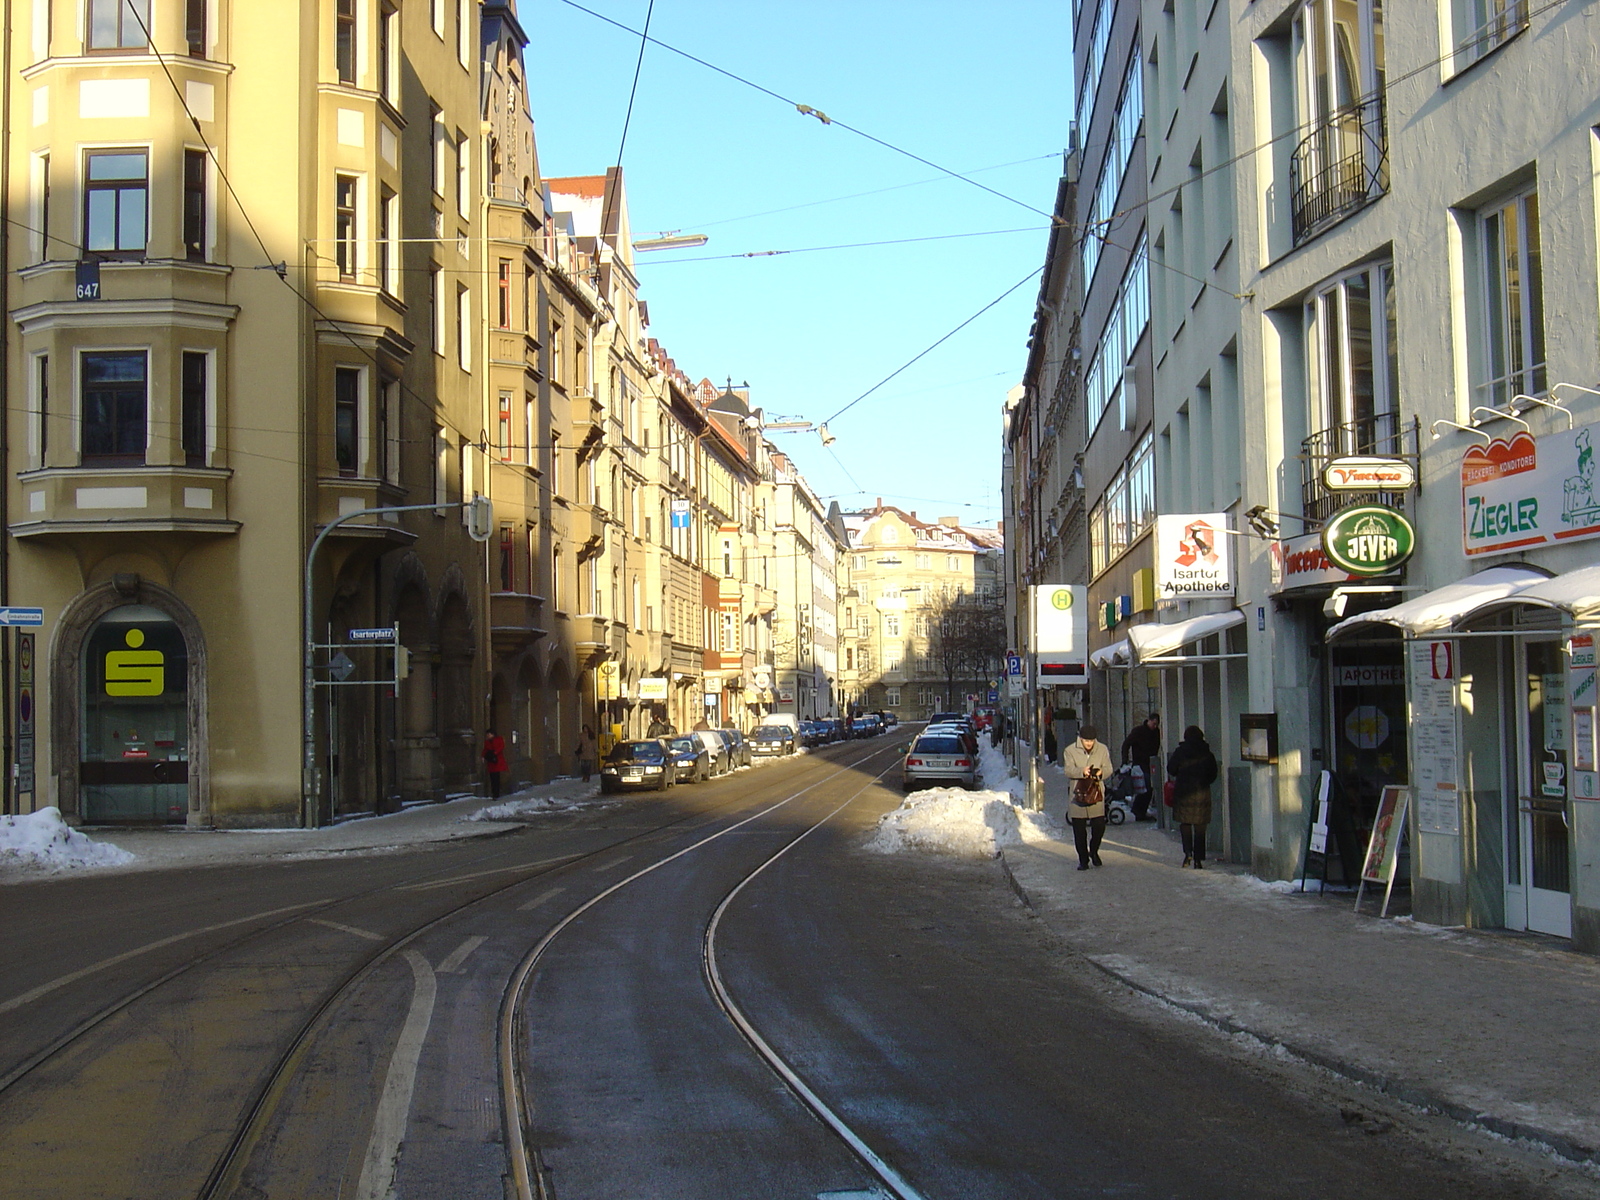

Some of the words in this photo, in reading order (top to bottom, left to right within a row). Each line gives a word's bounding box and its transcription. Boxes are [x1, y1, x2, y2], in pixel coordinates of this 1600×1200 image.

[77, 283, 99, 299] 647
[1467, 465, 1495, 482] BÄCKEREI
[1499, 454, 1536, 473] KONDITOREI
[1346, 534, 1399, 562] JEVER
[1164, 579, 1231, 594] Apotheke
[1057, 594, 1068, 606] H
[352, 630, 392, 640] Isartorplatz
[1010, 658, 1018, 675] P
[1573, 672, 1595, 702] IMBISS
